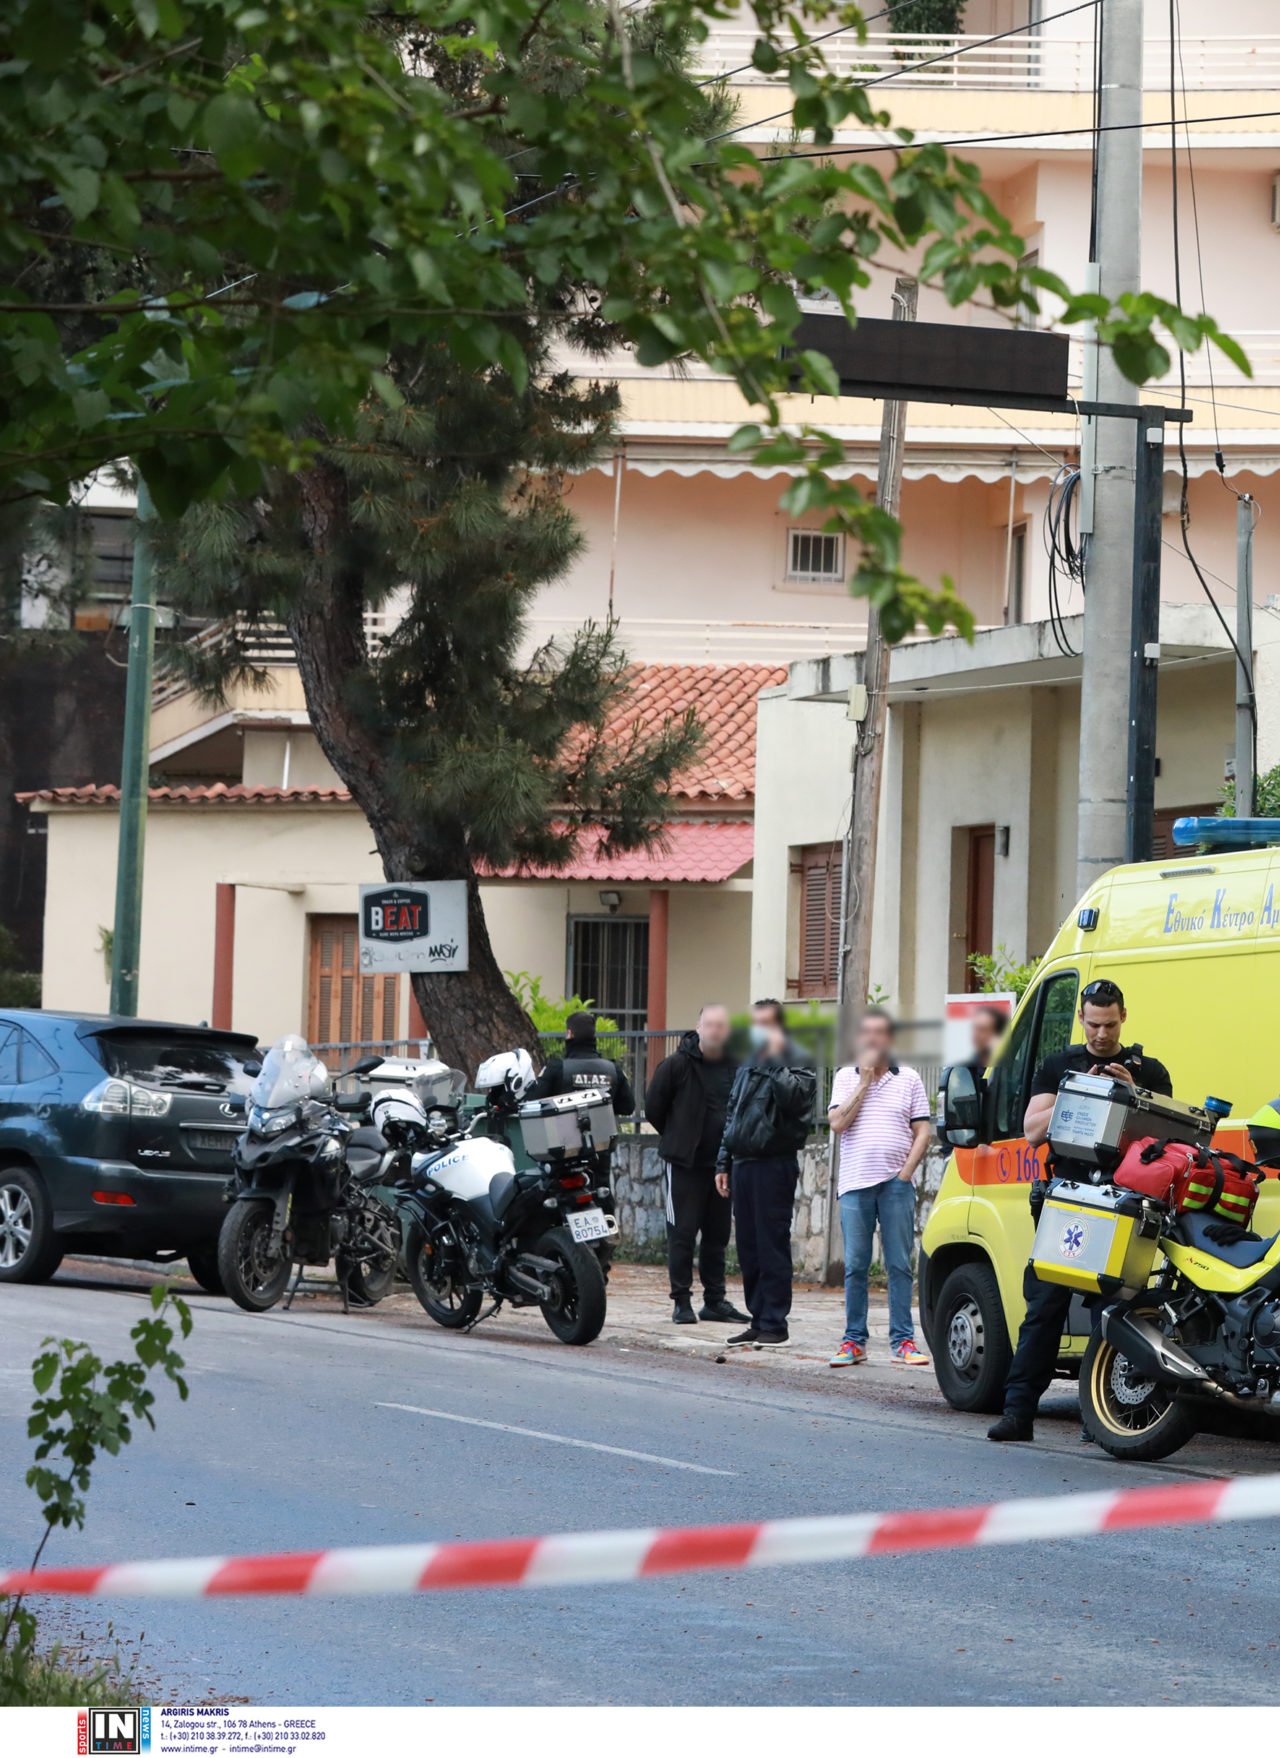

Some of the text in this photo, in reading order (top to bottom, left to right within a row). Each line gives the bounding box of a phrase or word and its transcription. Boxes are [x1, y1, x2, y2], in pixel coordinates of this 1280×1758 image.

[371, 905, 422, 930] BEAT
[1163, 893, 1205, 933] Εθνικό
[1210, 888, 1255, 931] Κέντρο
[1016, 1146, 1040, 1181] 166
[575, 1224, 608, 1240] 80754
